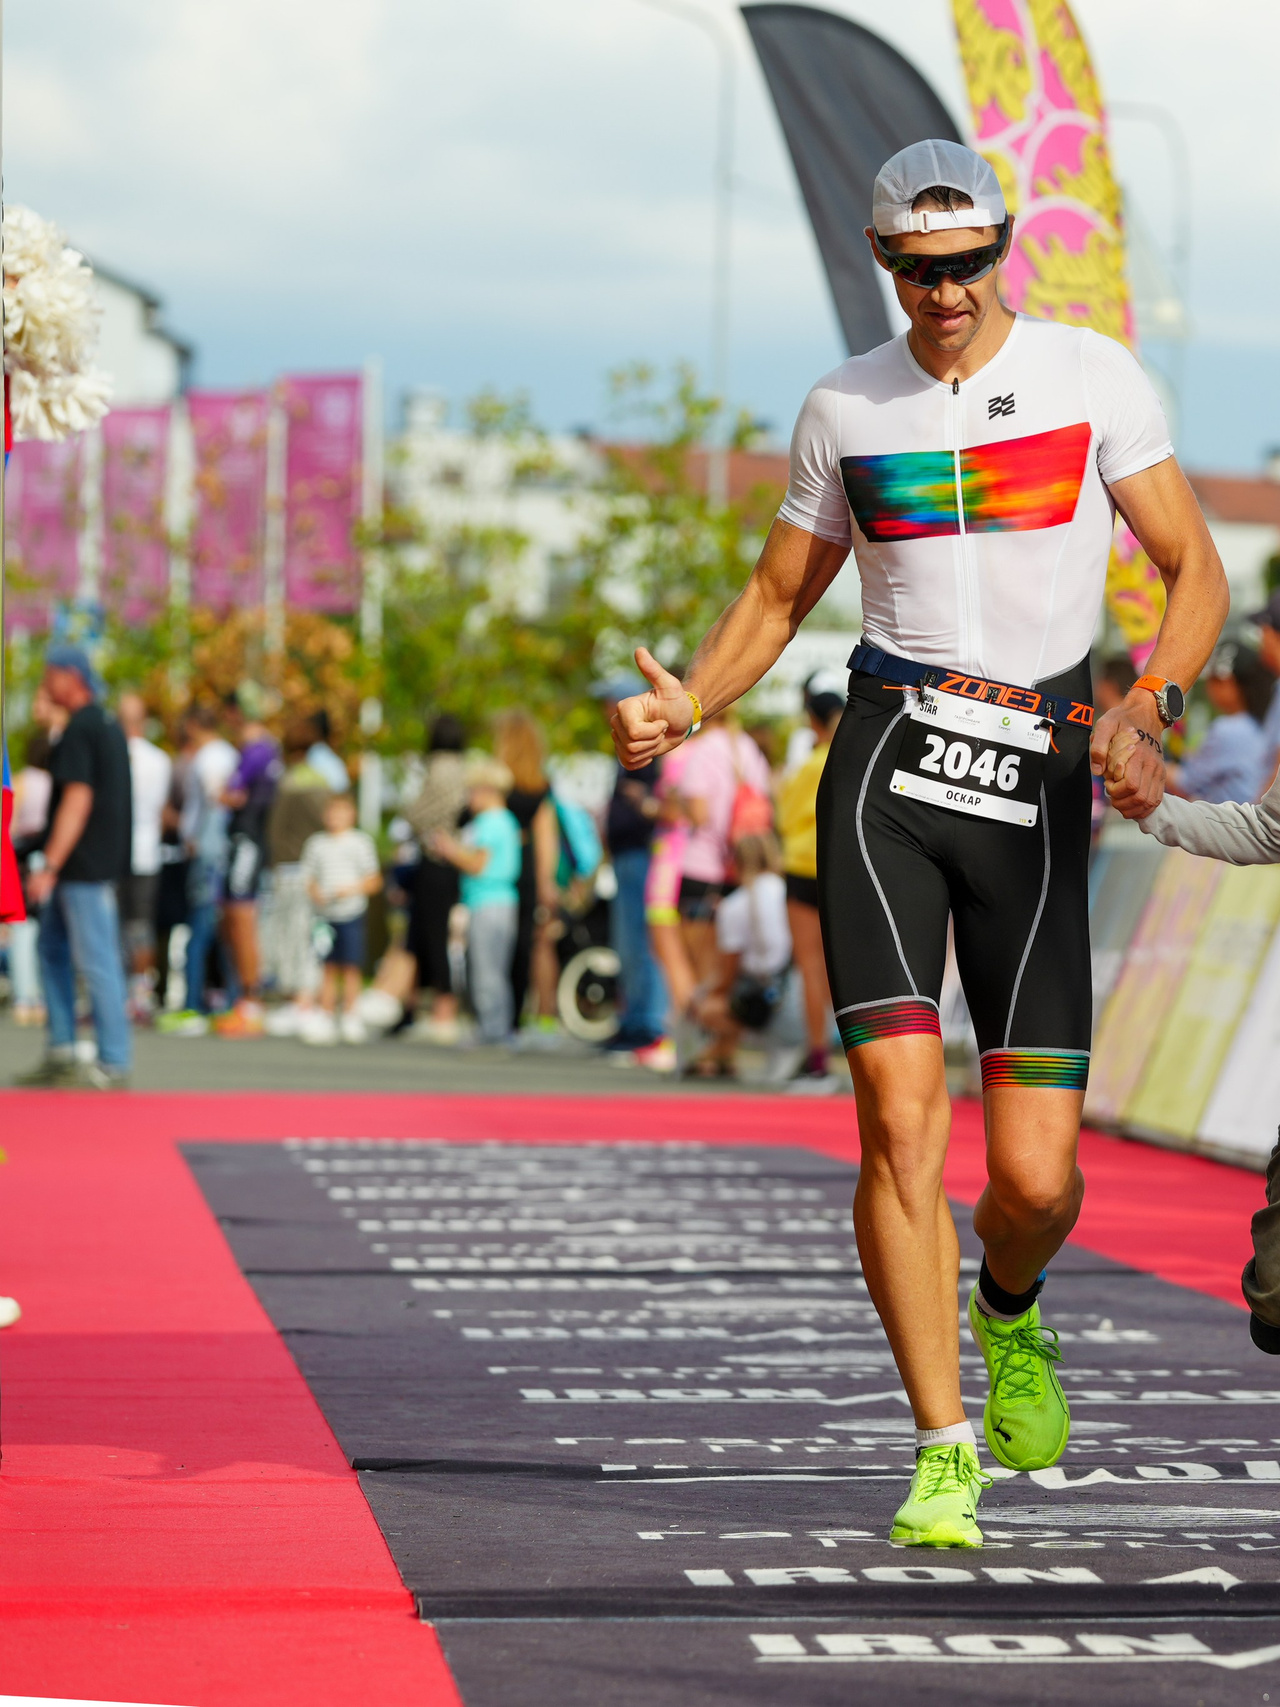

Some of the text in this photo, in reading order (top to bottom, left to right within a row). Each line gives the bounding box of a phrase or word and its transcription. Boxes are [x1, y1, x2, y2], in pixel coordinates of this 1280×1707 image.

[938, 672, 1042, 713] ZONE3
[919, 702, 938, 716] STAR
[918, 733, 1022, 792] 2046
[946, 790, 982, 806] ОСКАР
[683, 1567, 1105, 1587] IRON
[750, 1632, 1213, 1656] IRON
